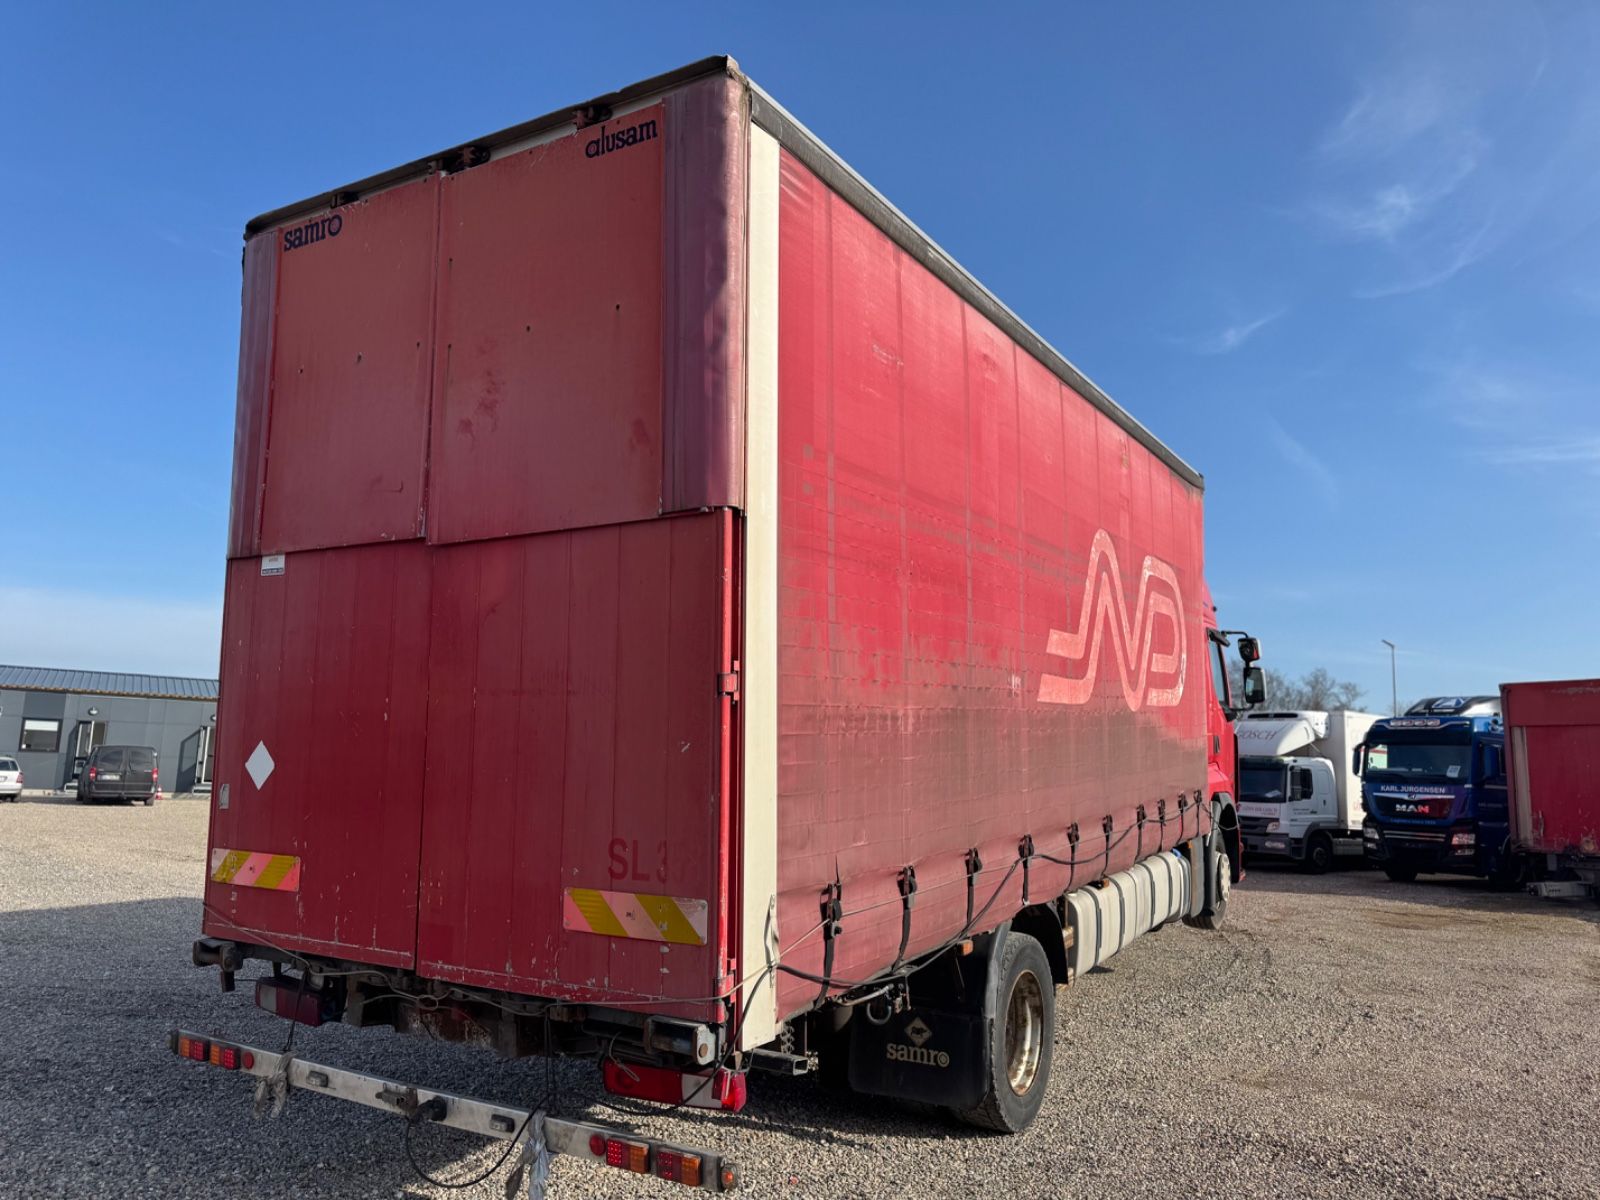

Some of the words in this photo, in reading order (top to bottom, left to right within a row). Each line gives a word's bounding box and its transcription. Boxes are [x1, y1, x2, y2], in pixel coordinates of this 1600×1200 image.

[585, 120, 658, 158] alusam
[283, 214, 343, 252] samro
[1380, 784, 1399, 792] KARL
[1395, 803, 1430, 814] MAN
[886, 1042, 950, 1068] samro
